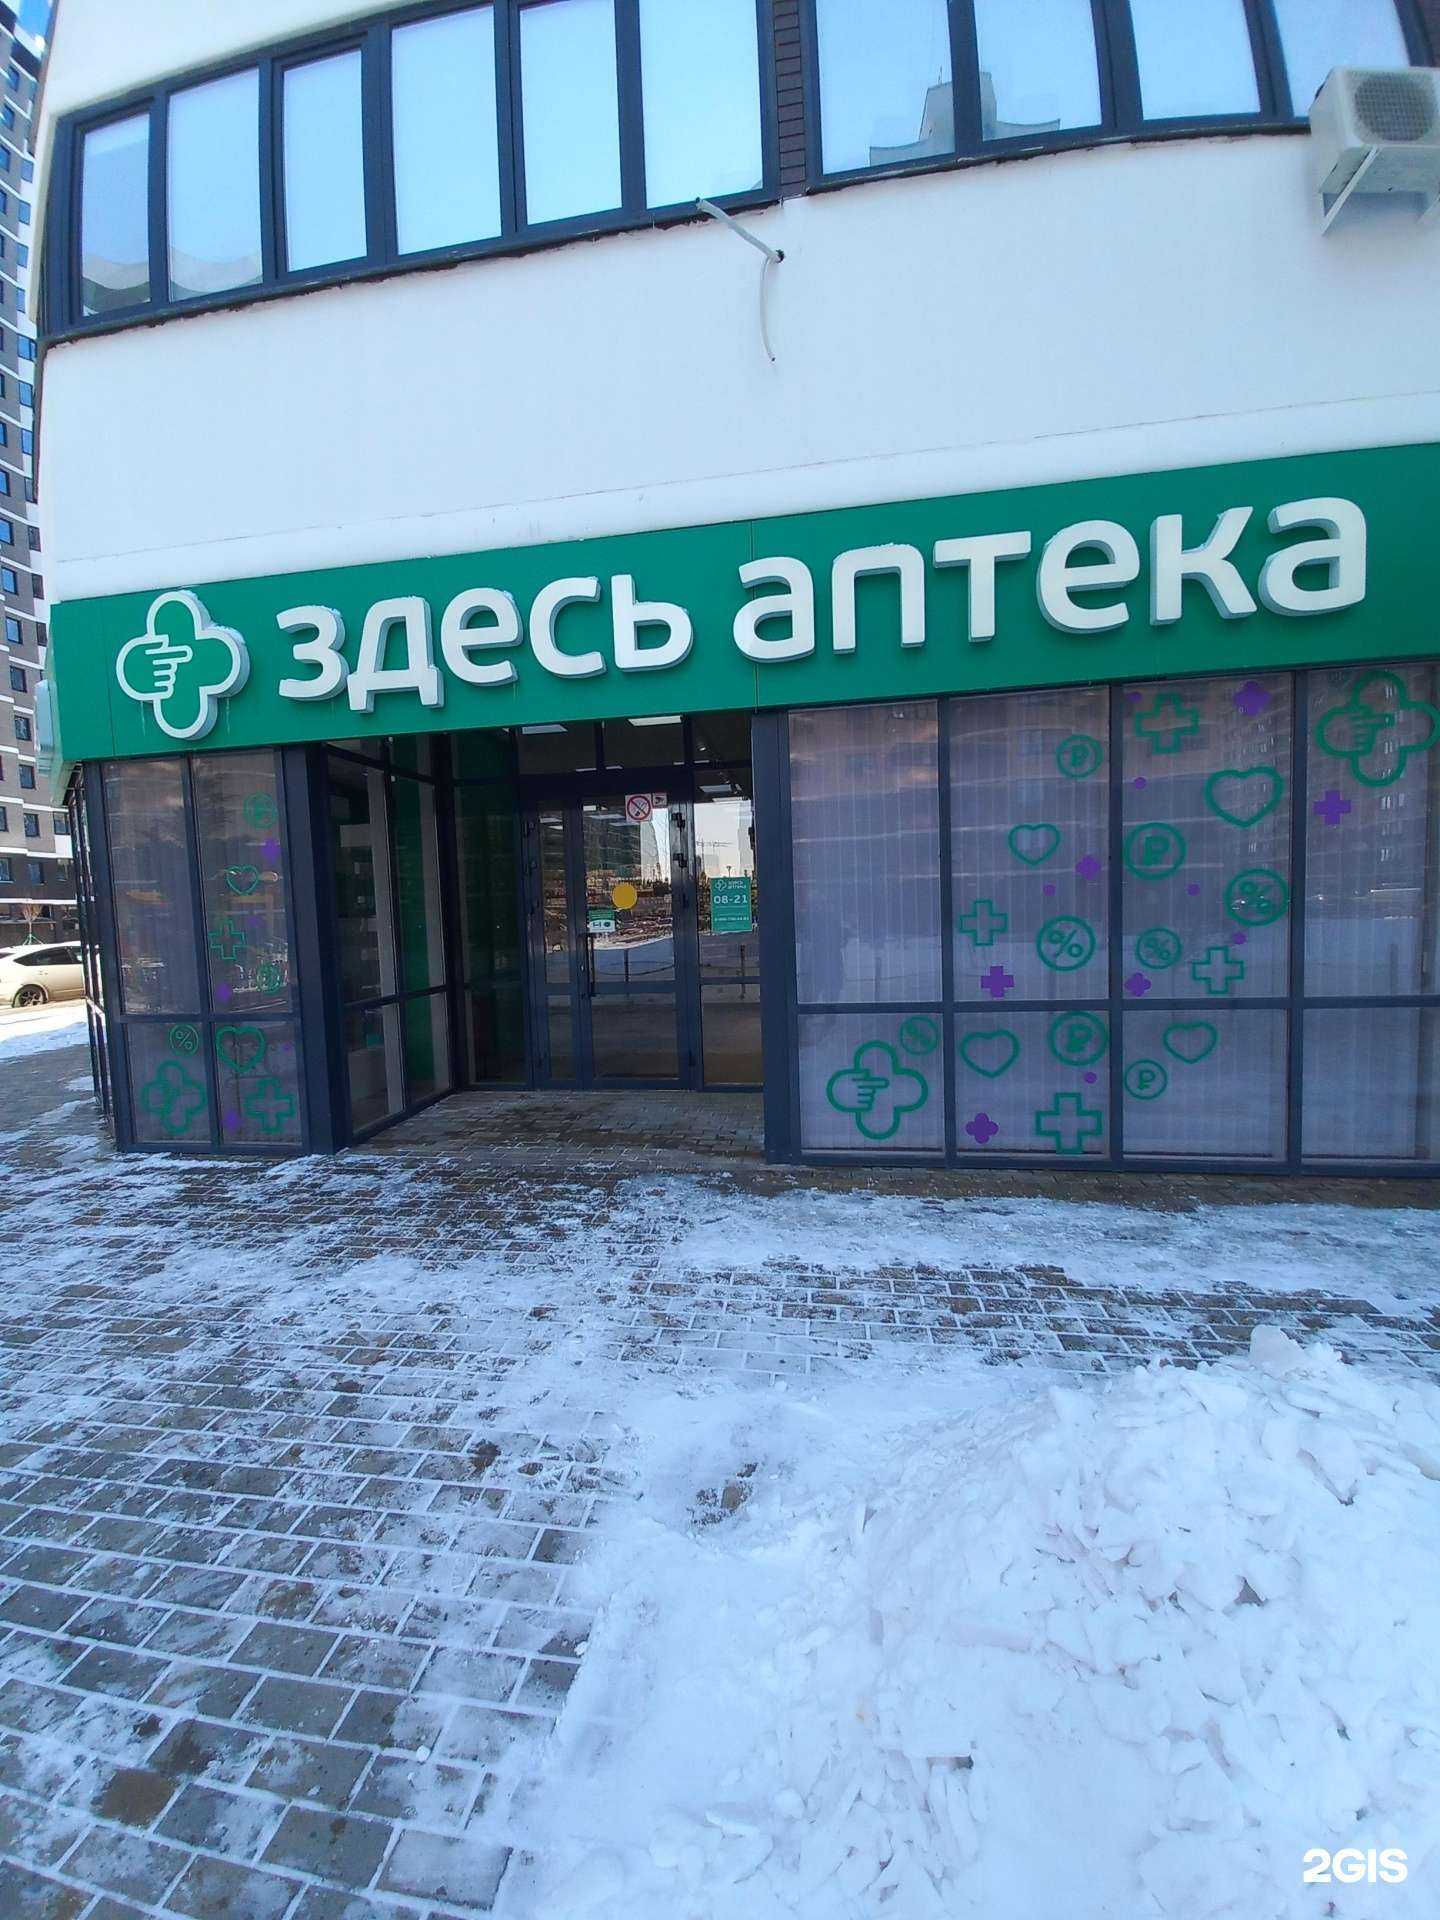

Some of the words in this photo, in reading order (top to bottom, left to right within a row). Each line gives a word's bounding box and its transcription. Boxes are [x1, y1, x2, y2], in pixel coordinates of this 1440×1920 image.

[276, 574, 694, 713] здесь
[733, 496, 1368, 663] аптека
[713, 894, 749, 904] 08-21
